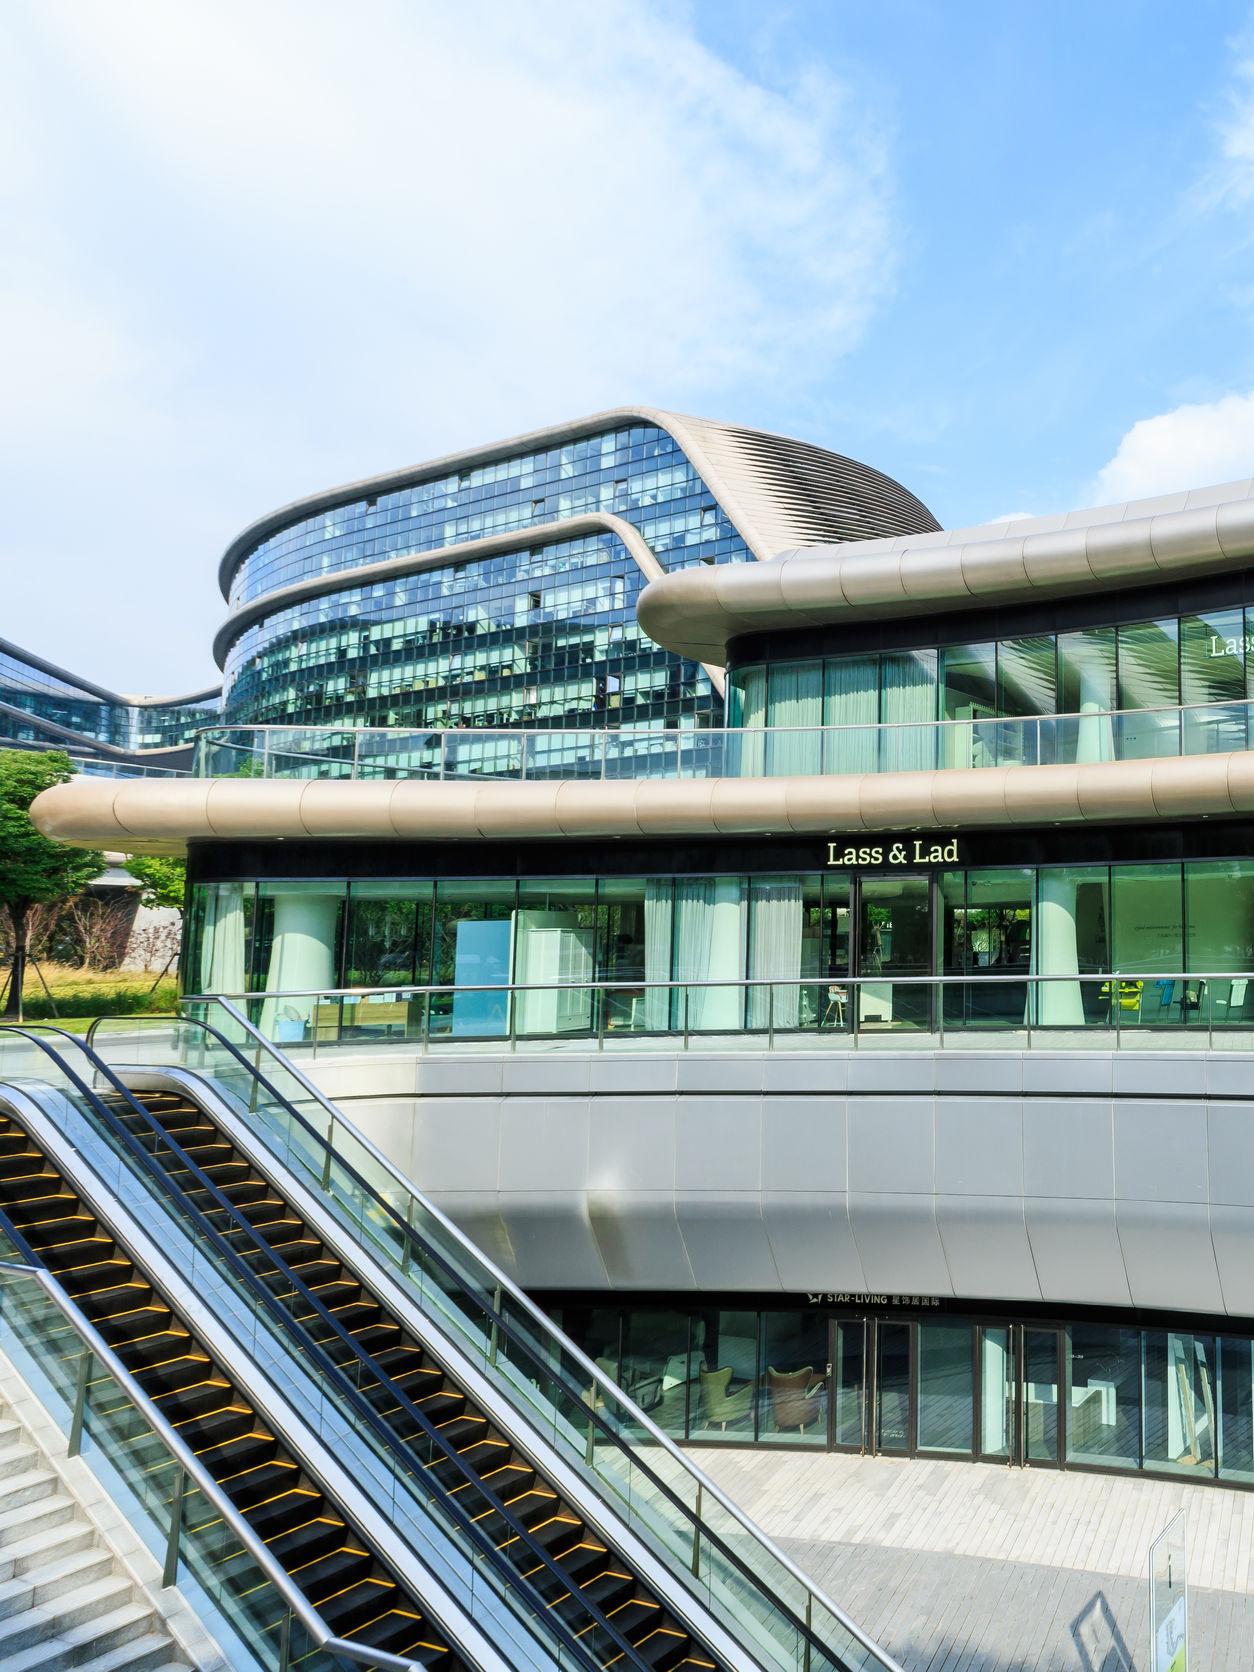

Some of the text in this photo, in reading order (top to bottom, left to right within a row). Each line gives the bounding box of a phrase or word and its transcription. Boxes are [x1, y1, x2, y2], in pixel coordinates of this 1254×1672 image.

[827, 839, 959, 865] Lass & Lad
[827, 1293, 888, 1304] STAR-LIVING
